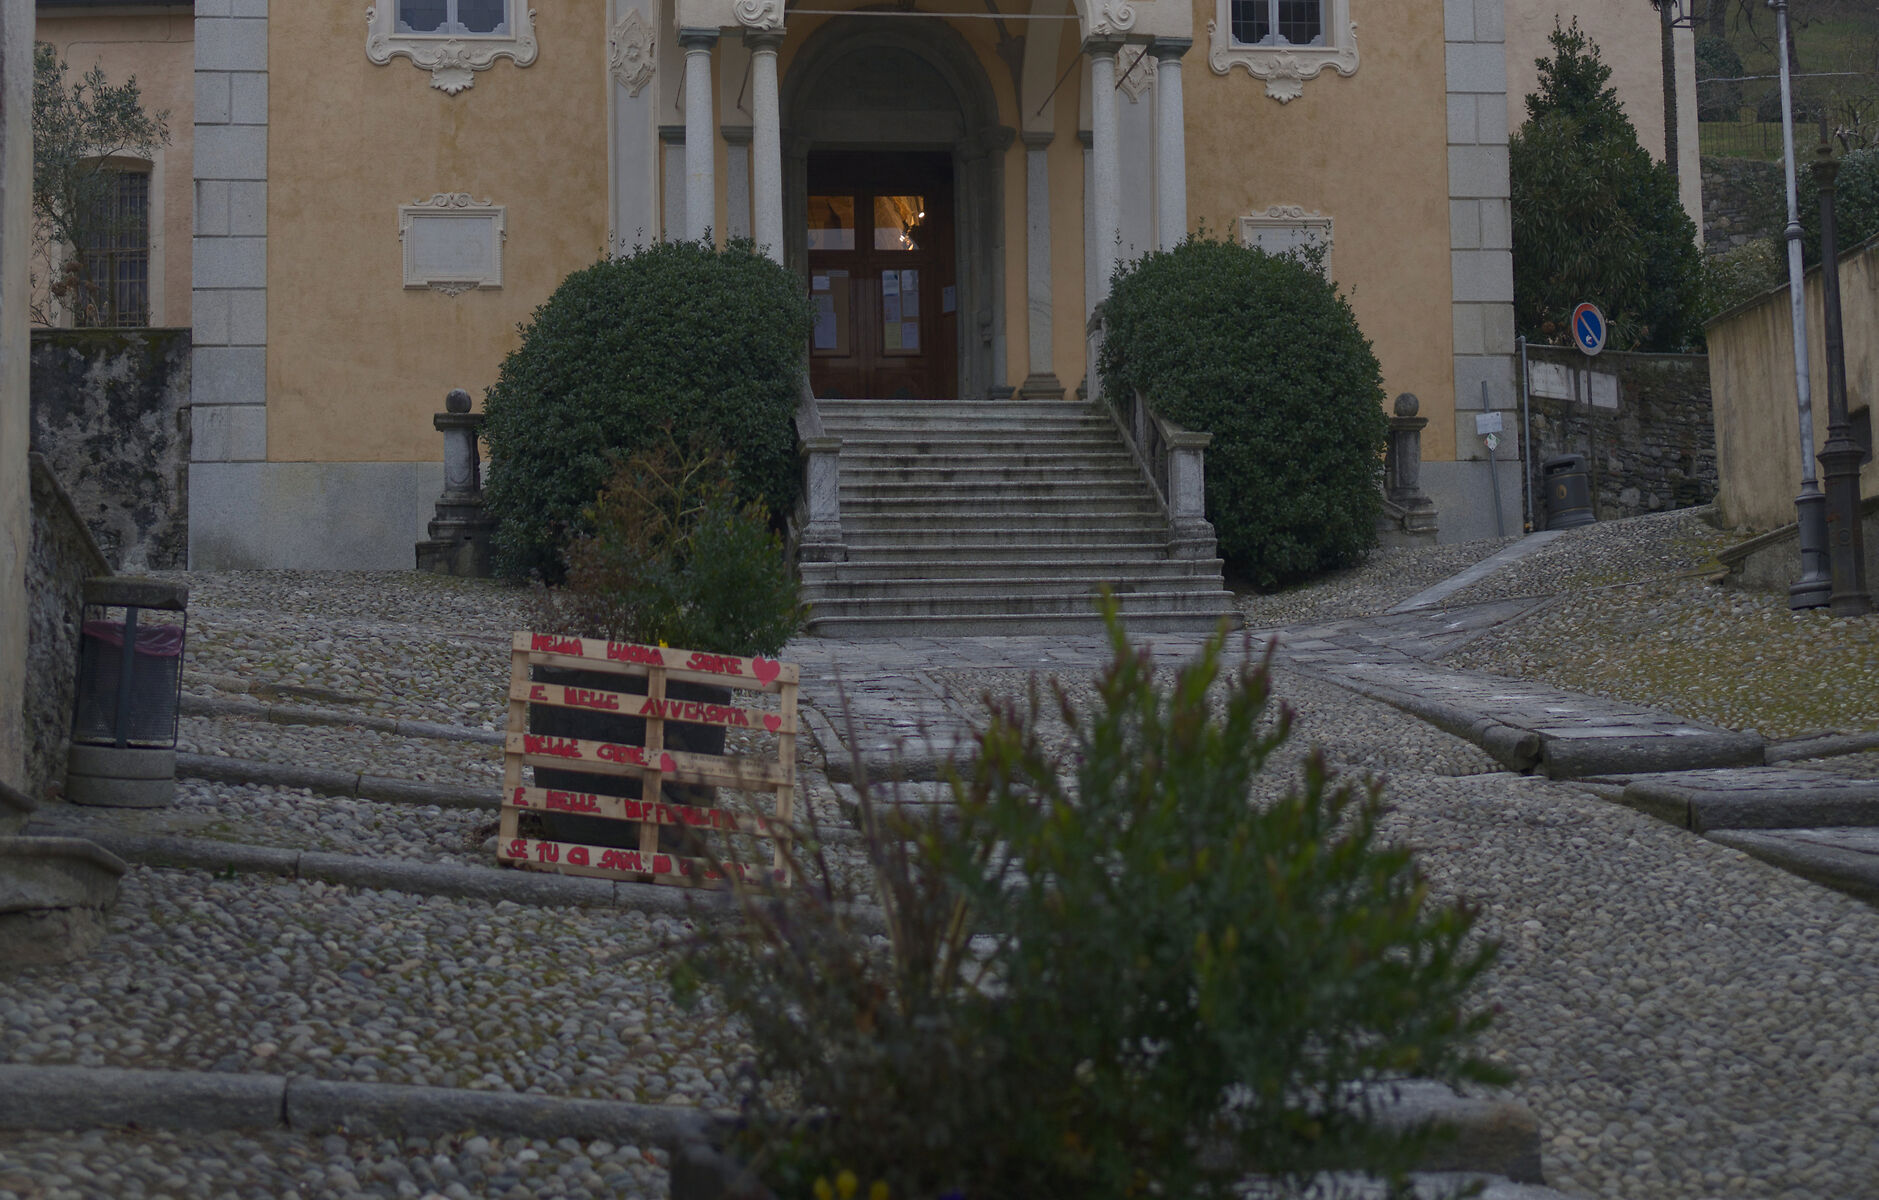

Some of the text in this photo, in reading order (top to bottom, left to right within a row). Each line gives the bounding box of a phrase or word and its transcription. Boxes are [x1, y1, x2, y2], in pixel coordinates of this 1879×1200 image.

[531, 633, 743, 674] NELLA BUONA SORTE
[530, 685, 548, 701] E
[564, 688, 619, 709] NELLE
[524, 735, 648, 765] NELLE GIOIE
[513, 787, 528, 805] E
[546, 790, 600, 812] NELLE
[506, 840, 528, 860] SE
[535, 841, 559, 864] TU
[567, 847, 590, 867] CI
